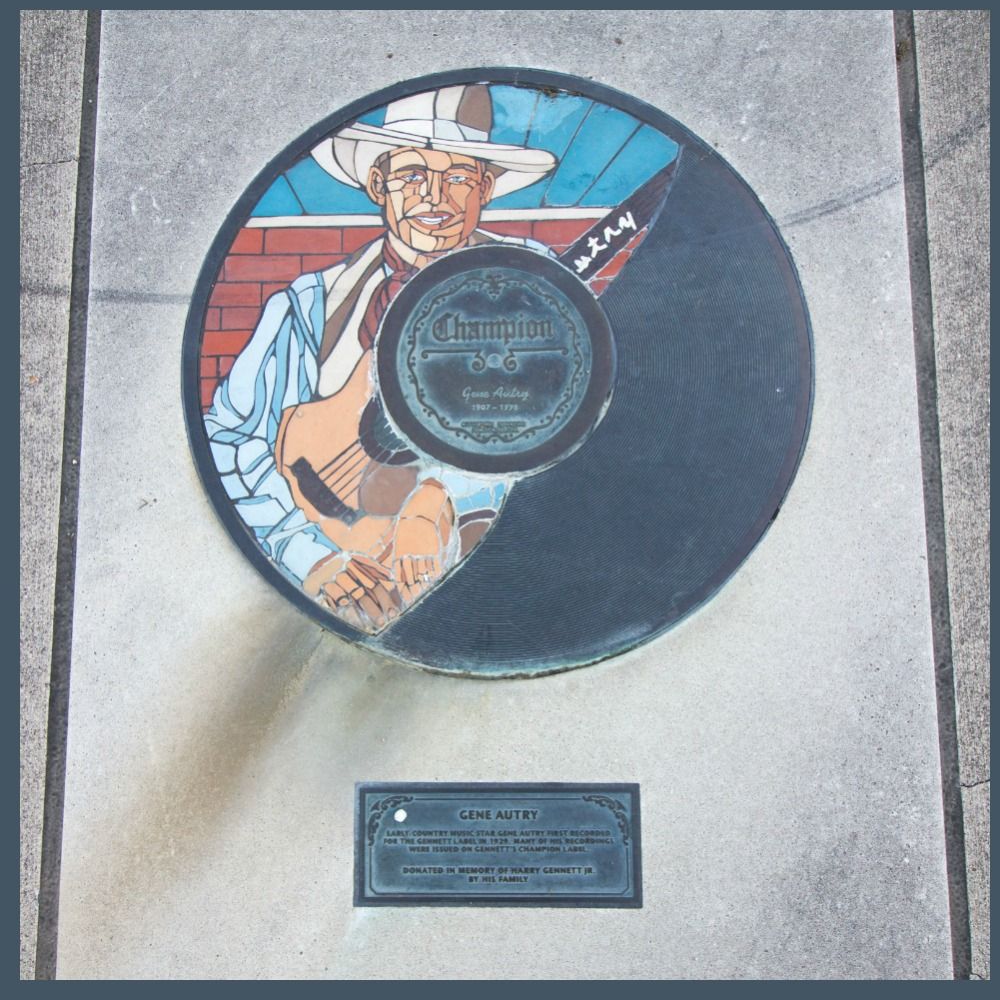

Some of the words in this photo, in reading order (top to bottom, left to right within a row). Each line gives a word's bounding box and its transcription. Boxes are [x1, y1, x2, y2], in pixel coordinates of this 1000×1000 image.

[432, 312, 554, 344] Champion
[460, 810, 492, 820] GENE
[496, 810, 538, 820] AUTRY
